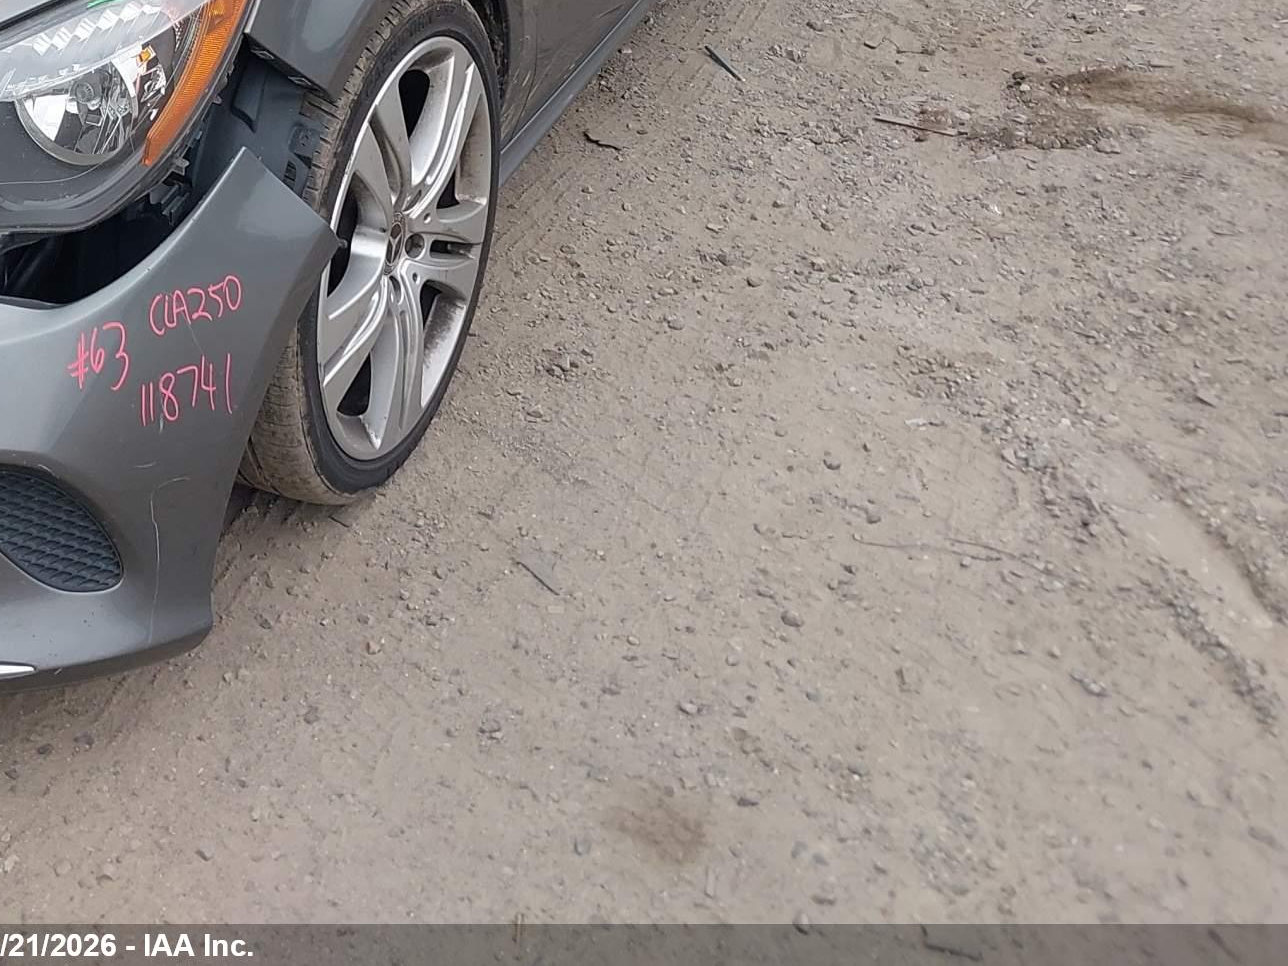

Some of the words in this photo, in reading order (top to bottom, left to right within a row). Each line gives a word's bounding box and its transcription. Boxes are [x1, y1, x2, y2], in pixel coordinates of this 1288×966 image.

[149, 274, 242, 336] CLA250
[66, 321, 130, 390] #63
[140, 353, 234, 427] 118741
